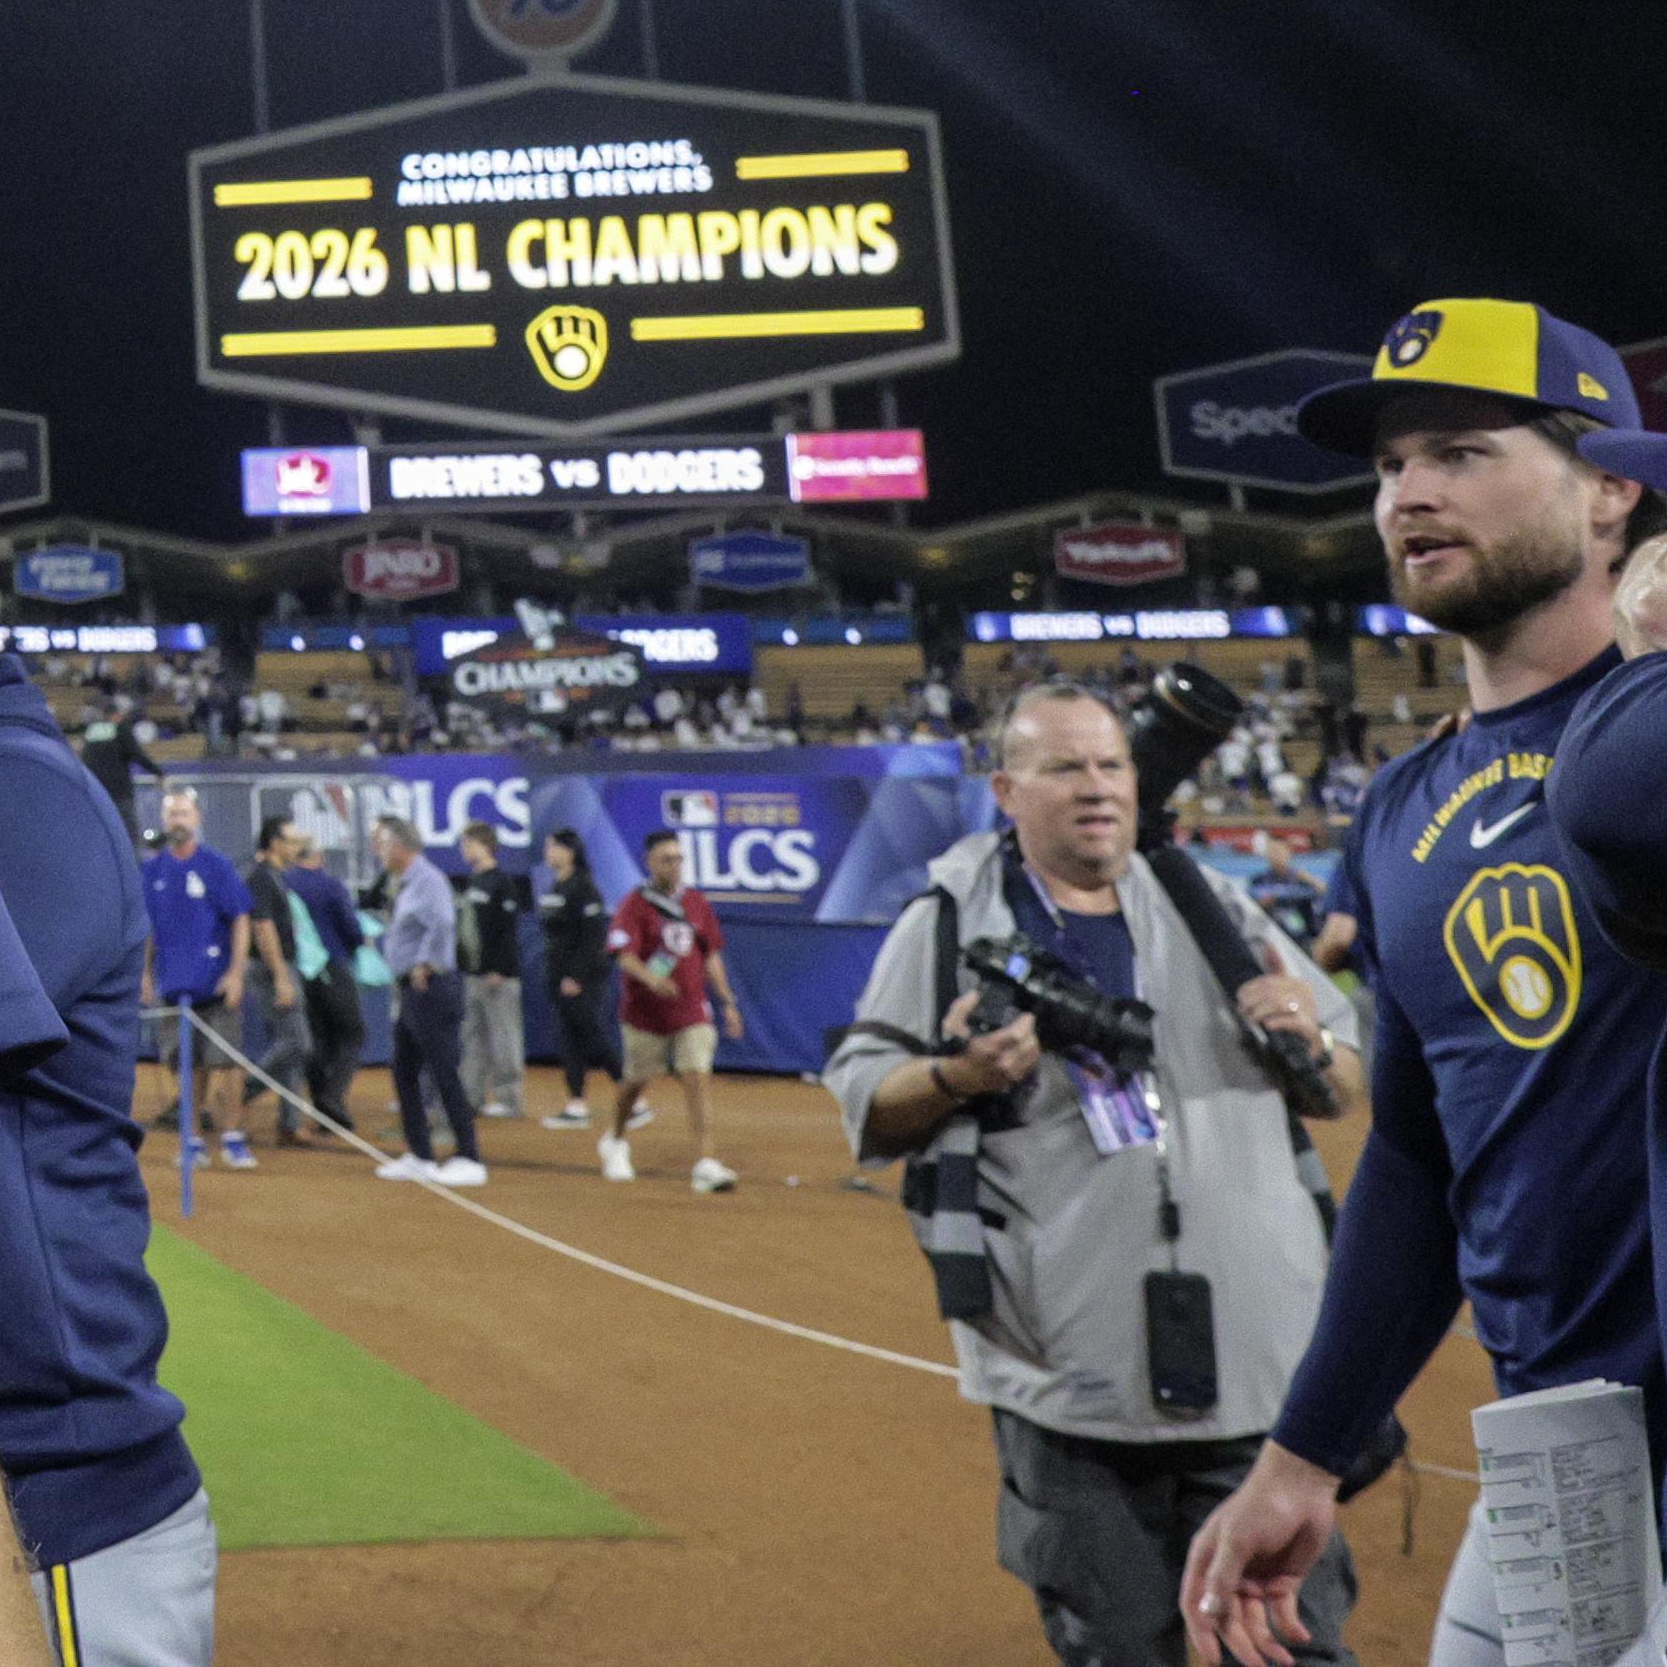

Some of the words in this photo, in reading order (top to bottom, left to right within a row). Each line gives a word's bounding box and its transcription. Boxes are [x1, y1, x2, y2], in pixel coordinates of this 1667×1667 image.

[401, 138, 703, 181] CONGRATULATIONS,
[397, 173, 568, 206] MILWAUKEE
[574, 164, 713, 198] BREWERS
[234, 229, 388, 301] 2026
[407, 223, 491, 293] NL
[507, 202, 899, 289] CHAMPIONS
[1192, 401, 1298, 445] Spec
[389, 454, 544, 499] BREWERS
[607, 448, 764, 494] DODGERS
[454, 653, 639, 696] CHAMPIONS
